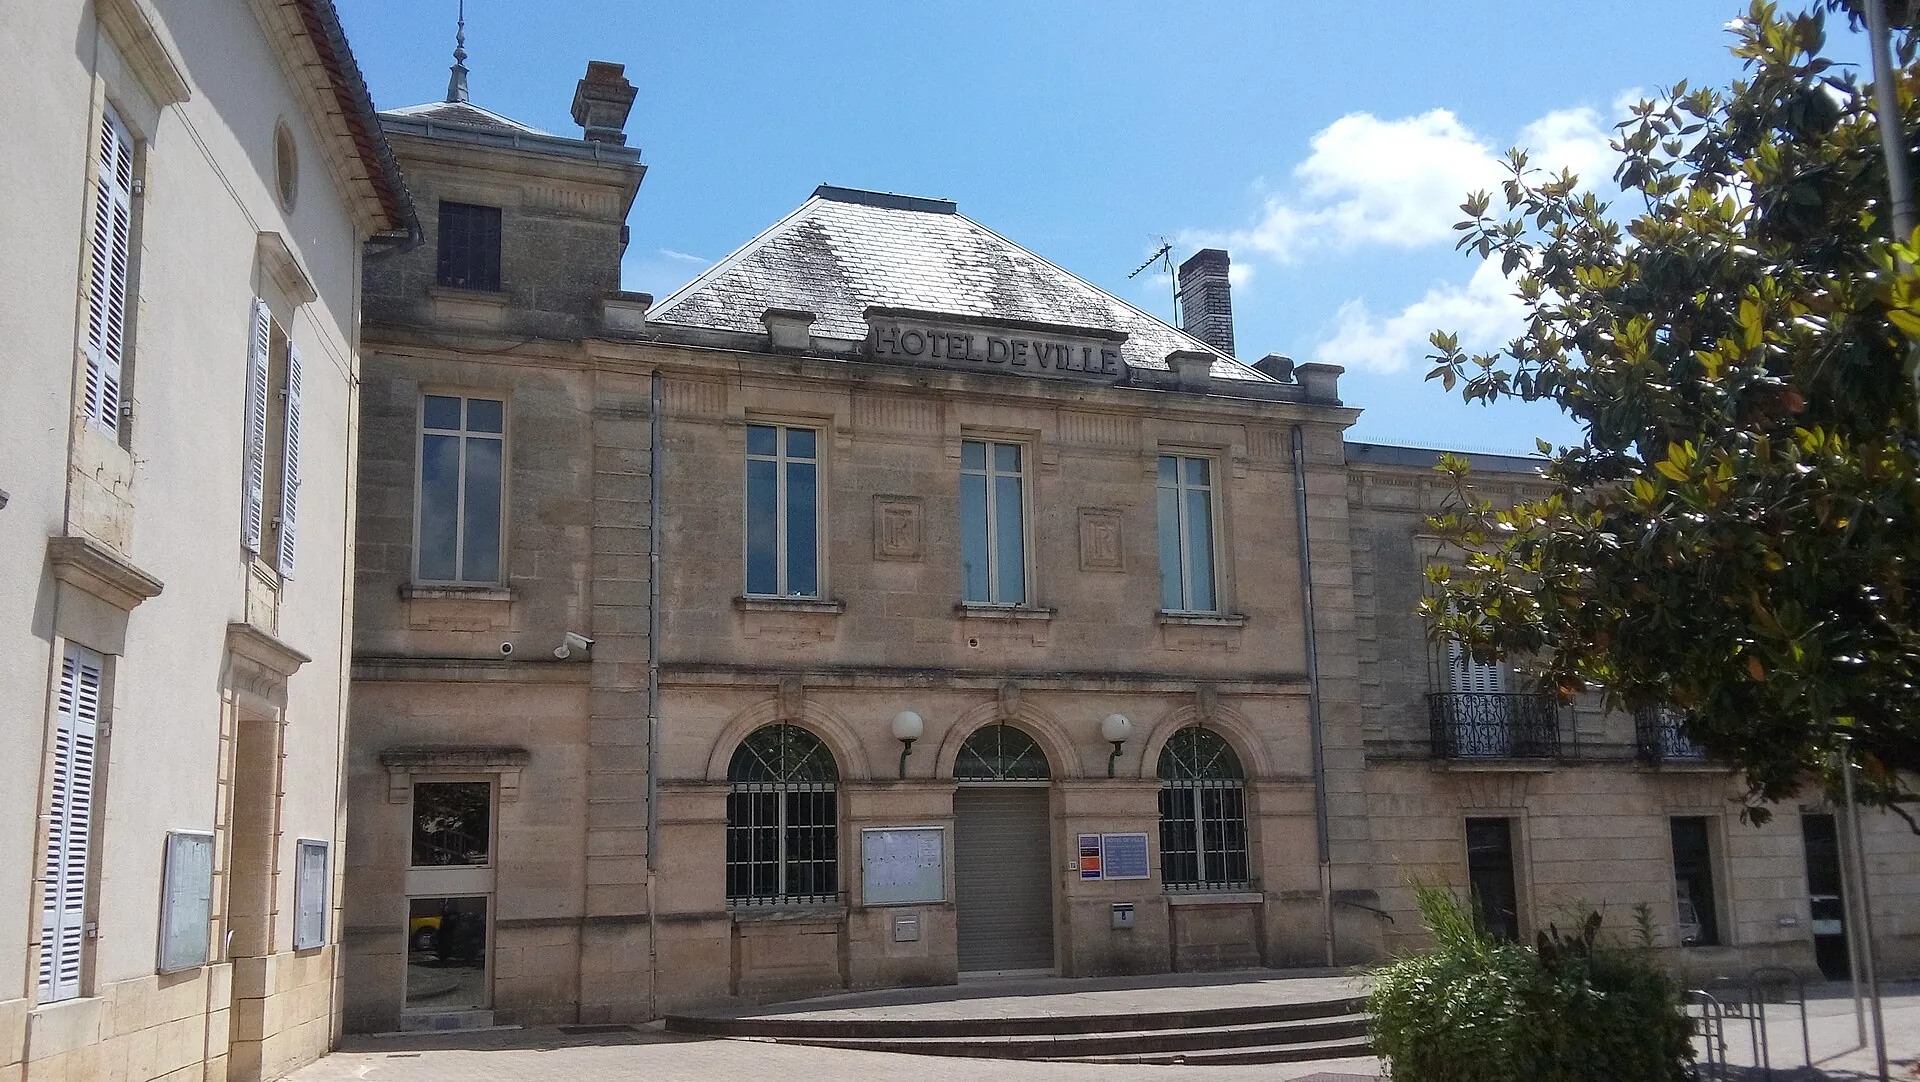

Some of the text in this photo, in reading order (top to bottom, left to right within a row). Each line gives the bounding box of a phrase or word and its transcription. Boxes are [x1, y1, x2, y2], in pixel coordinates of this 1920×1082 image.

[875, 327, 1118, 375] HOTEL DE VILLE
